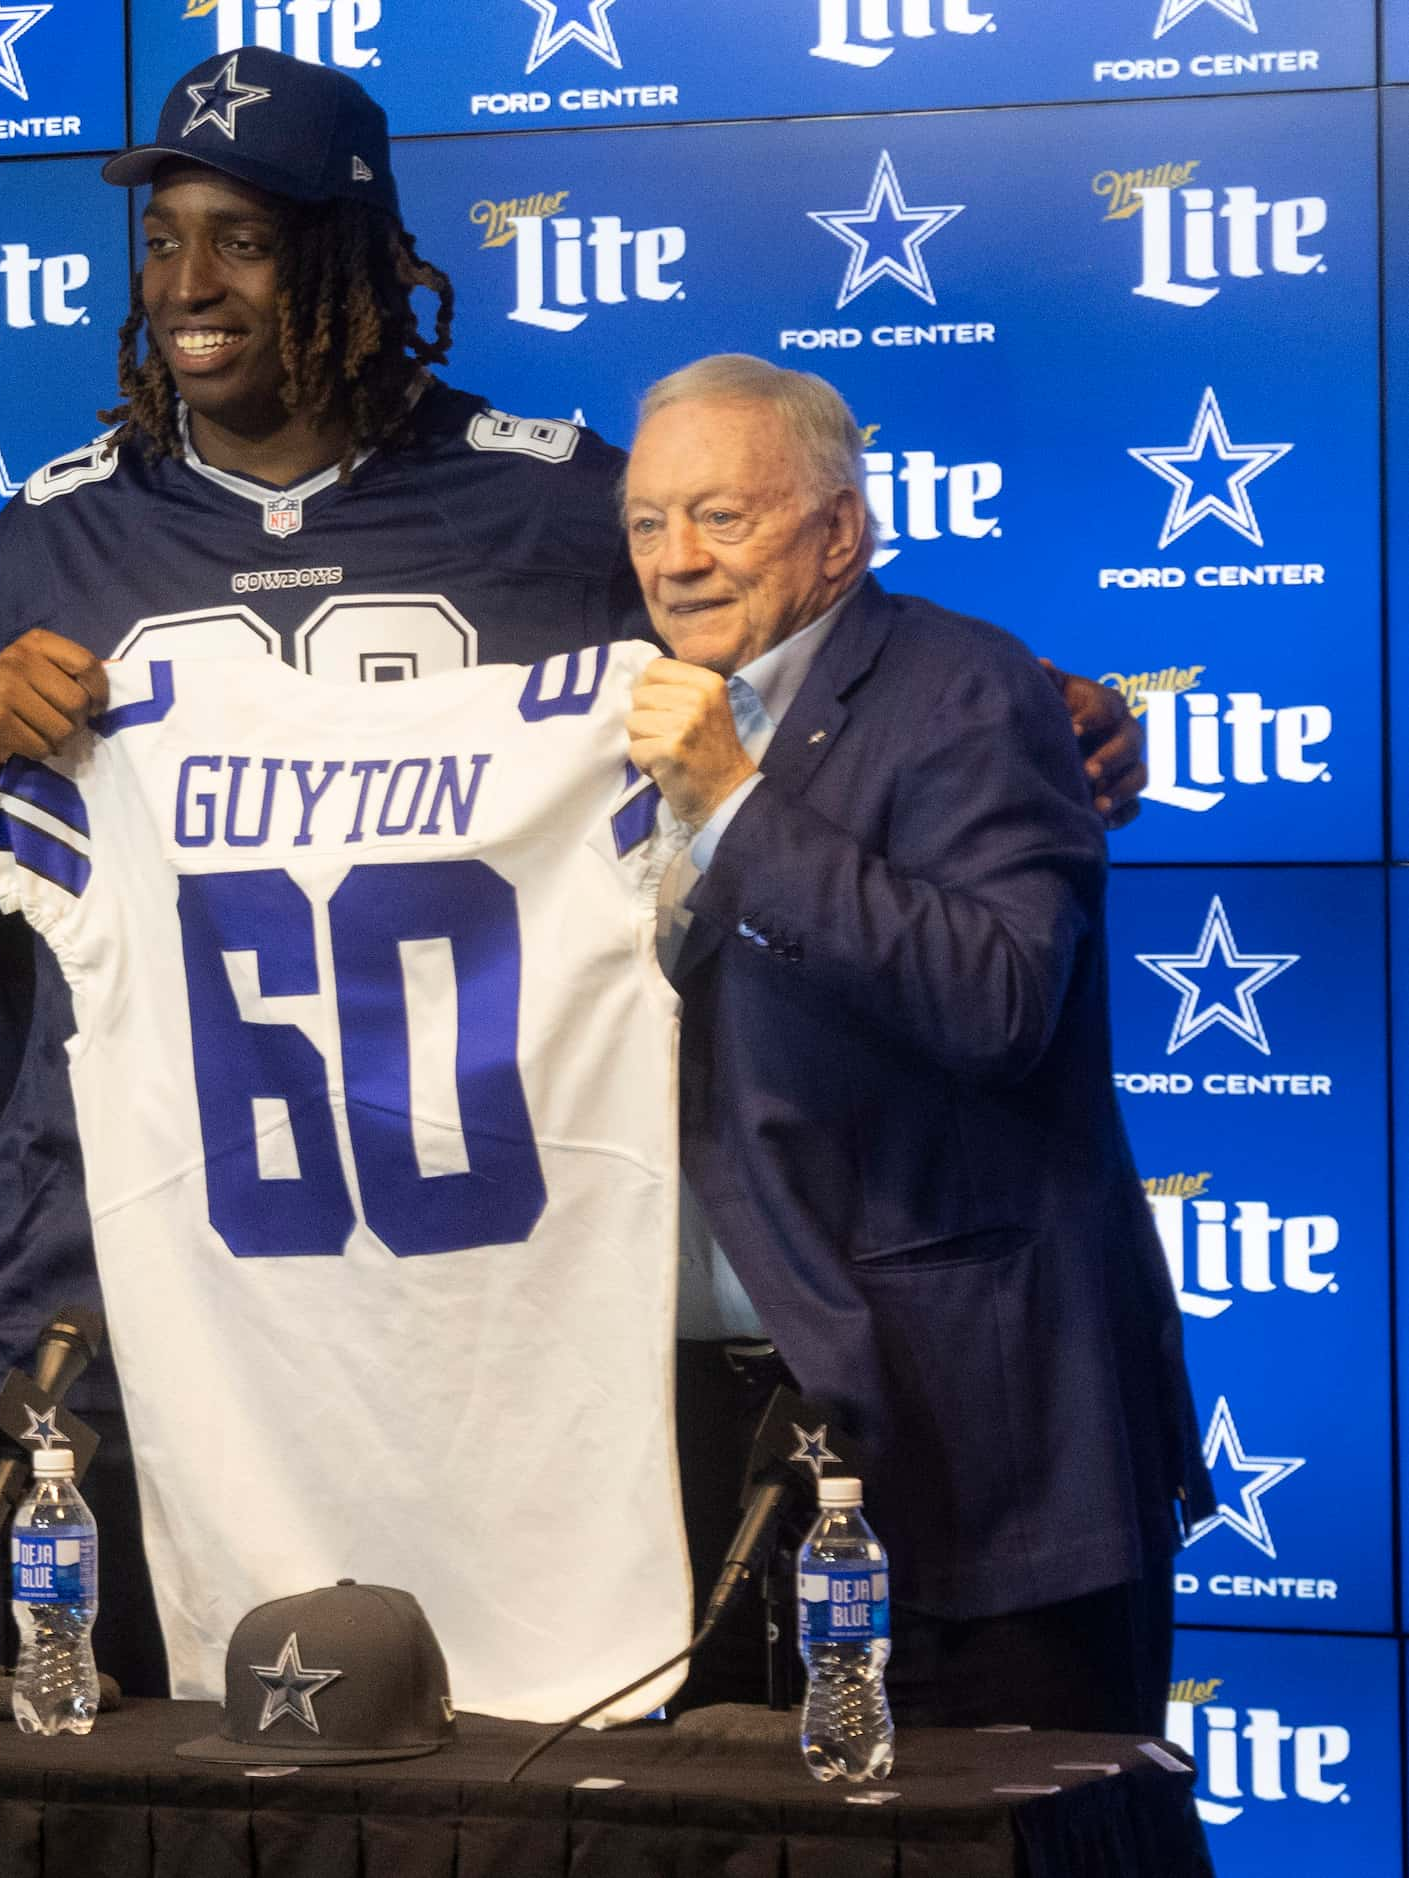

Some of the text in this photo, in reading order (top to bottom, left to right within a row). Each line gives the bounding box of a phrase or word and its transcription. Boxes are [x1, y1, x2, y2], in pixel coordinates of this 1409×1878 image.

[1093, 49, 1319, 81] FORD CENTER
[471, 85, 678, 114] FORD CENTER
[1093, 161, 1200, 219] Miller
[471, 191, 569, 248] Miller
[1131, 186, 1327, 306] Lite
[506, 216, 685, 331] Lite
[781, 324, 994, 349] FORD CENTER
[270, 511, 297, 529] NFL
[861, 451, 1003, 568] ite
[232, 567, 344, 593] COWBOYS
[1100, 564, 1324, 588] FORD CENTER
[1098, 665, 1206, 720] Miller
[1138, 690, 1332, 812] Lite
[174, 754, 492, 847] GUYTON
[177, 859, 548, 1258] 60
[1204, 1075, 1330, 1094] CENTER
[21, 1544, 52, 1565] DEJA
[21, 1567, 53, 1588] BLUE
[832, 1580, 870, 1602] DEJA
[1209, 1575, 1337, 1598] CENTER
[832, 1604, 871, 1627] BLUE
